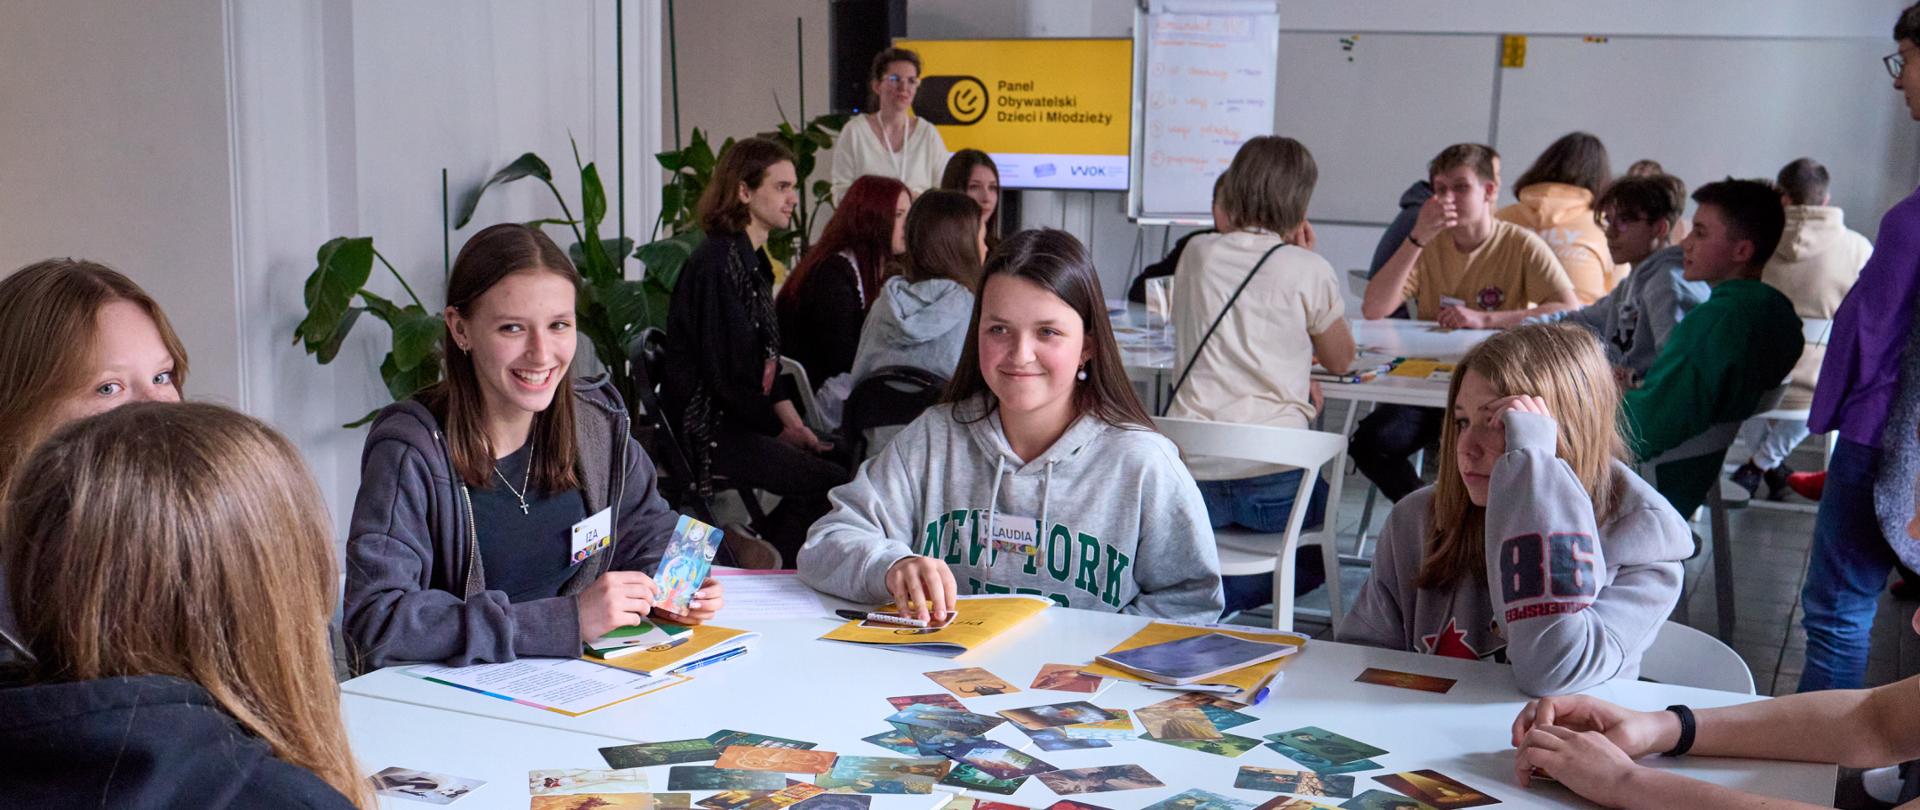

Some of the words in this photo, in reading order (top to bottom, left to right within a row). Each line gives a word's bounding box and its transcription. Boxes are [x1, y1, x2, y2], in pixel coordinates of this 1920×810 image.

[998, 80, 1034, 92] Panel
[998, 96, 1077, 108] Obywatelski
[998, 111, 1036, 122] Dzieci
[1047, 111, 1112, 125] Młodzieży
[585, 528, 598, 543] IZA
[984, 524, 1032, 541] LAUDIA
